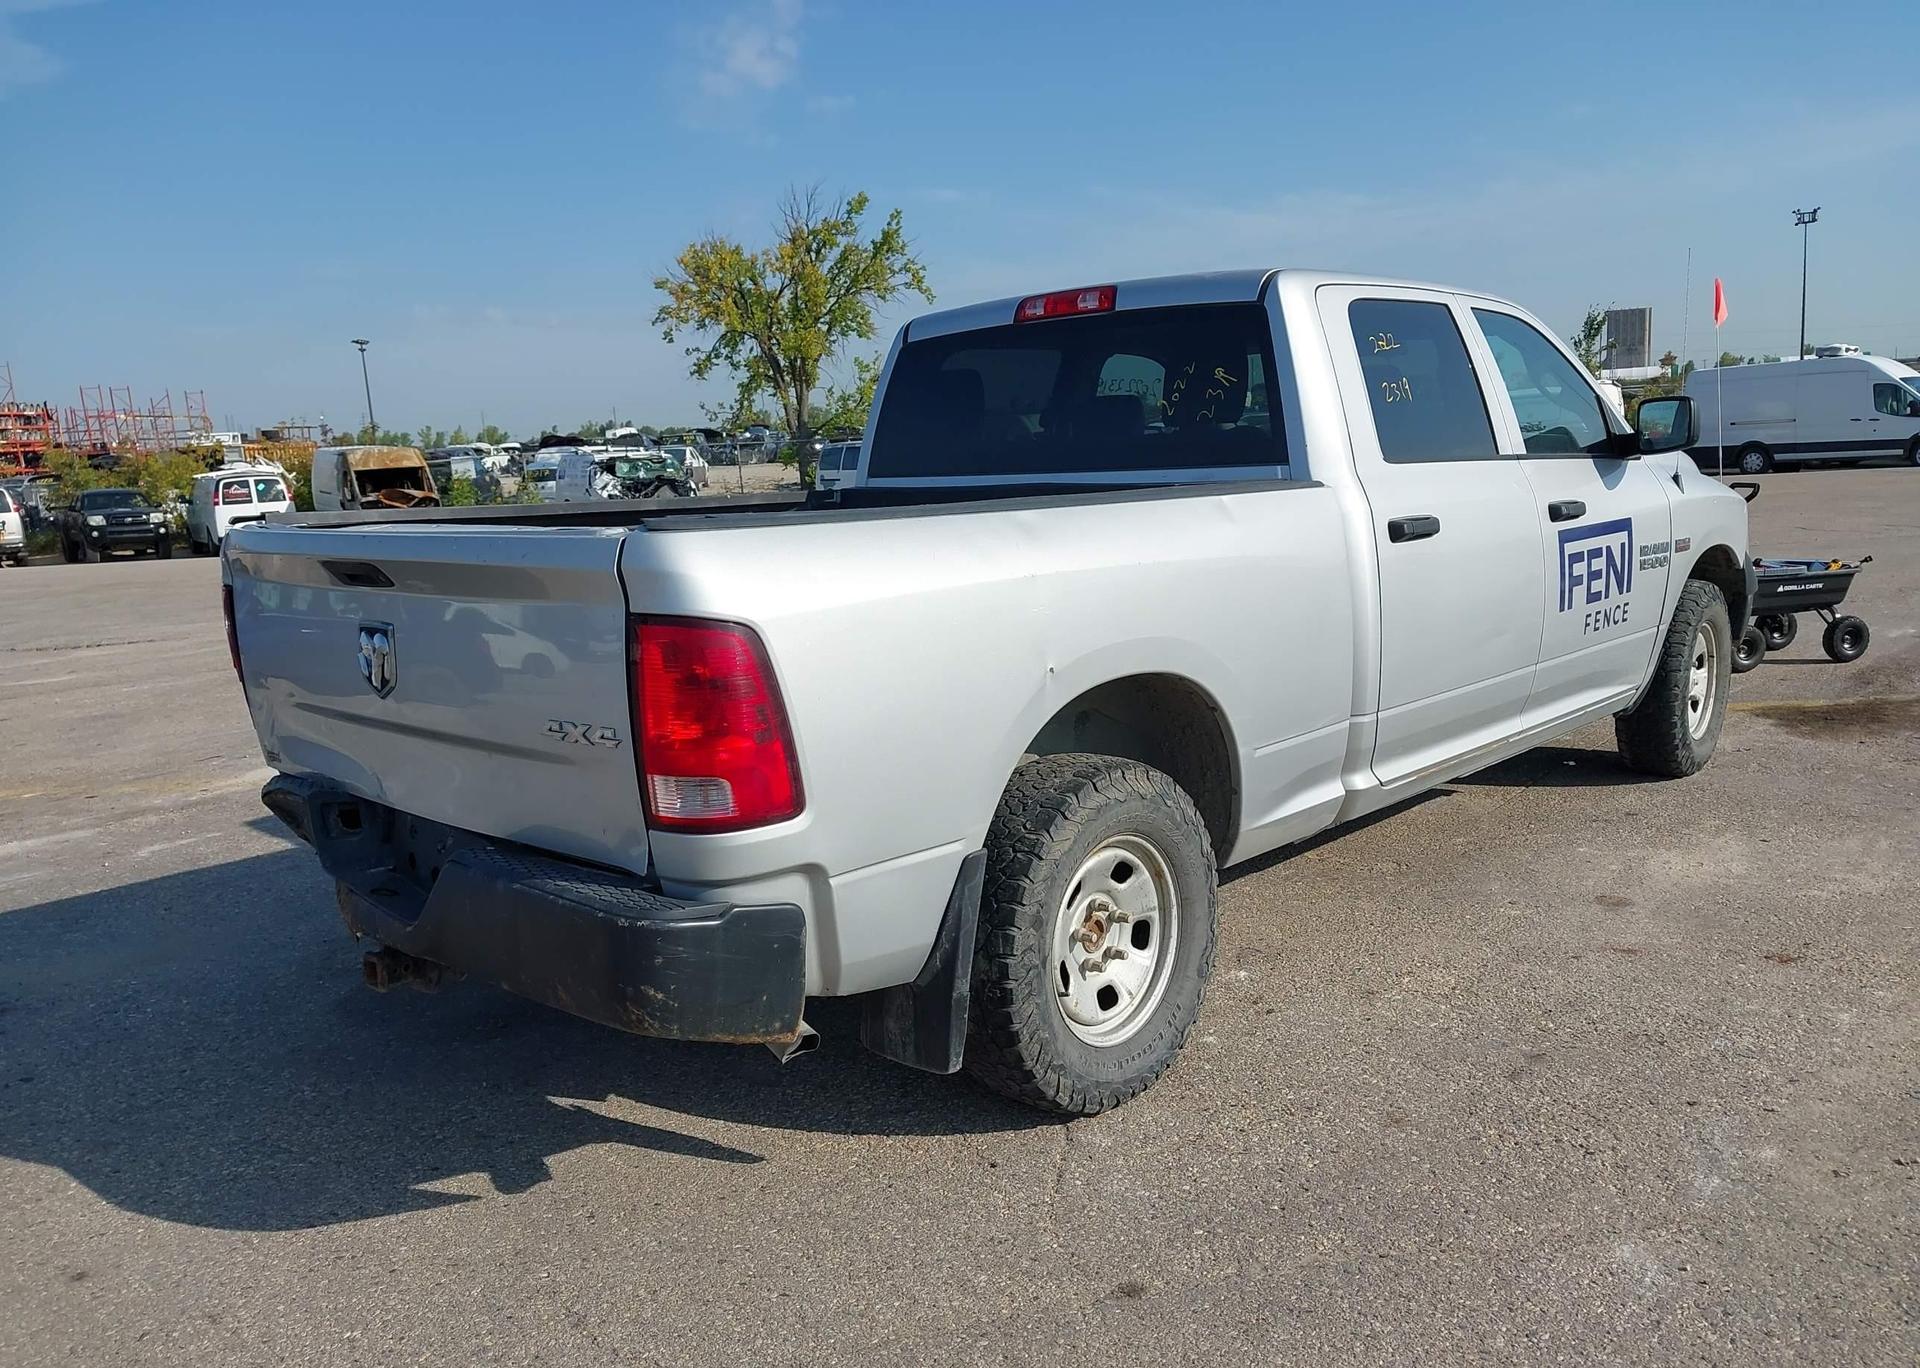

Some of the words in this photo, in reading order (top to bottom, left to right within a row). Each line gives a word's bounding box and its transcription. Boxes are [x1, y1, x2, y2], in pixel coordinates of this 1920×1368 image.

[1381, 377, 1413, 403] 2319
[1783, 584, 1805, 592] GORILLA
[1583, 602, 1630, 635] FENCE
